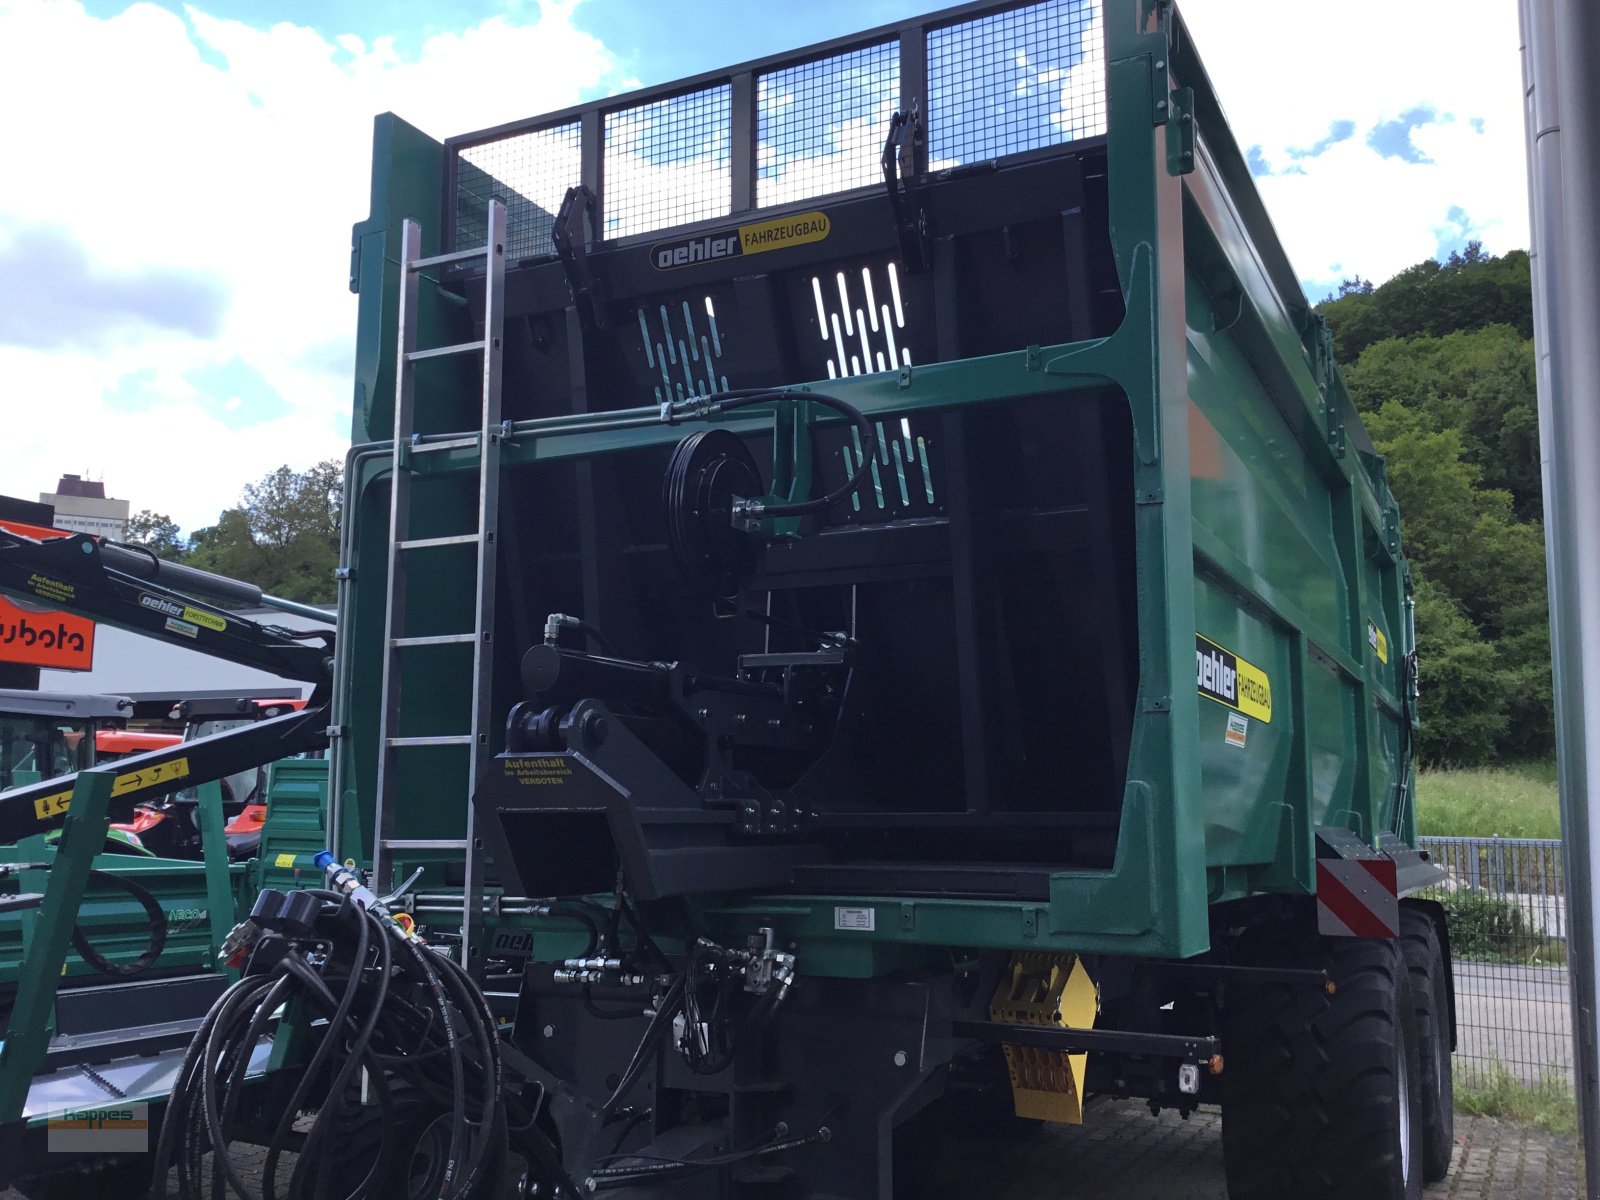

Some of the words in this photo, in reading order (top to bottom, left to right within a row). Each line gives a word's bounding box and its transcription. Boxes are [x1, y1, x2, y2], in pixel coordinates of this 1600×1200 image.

[658, 236, 737, 268] oehler
[744, 218, 826, 247] FAHRZEUGBAU
[30, 573, 75, 593] Aufenthalt
[141, 596, 184, 616] oehler
[0, 615, 84, 652] ubota
[1238, 672, 1270, 710] FAHRZEUGBAU
[505, 758, 566, 769] Aufenthalt
[519, 777, 563, 785] VERBOTEN
